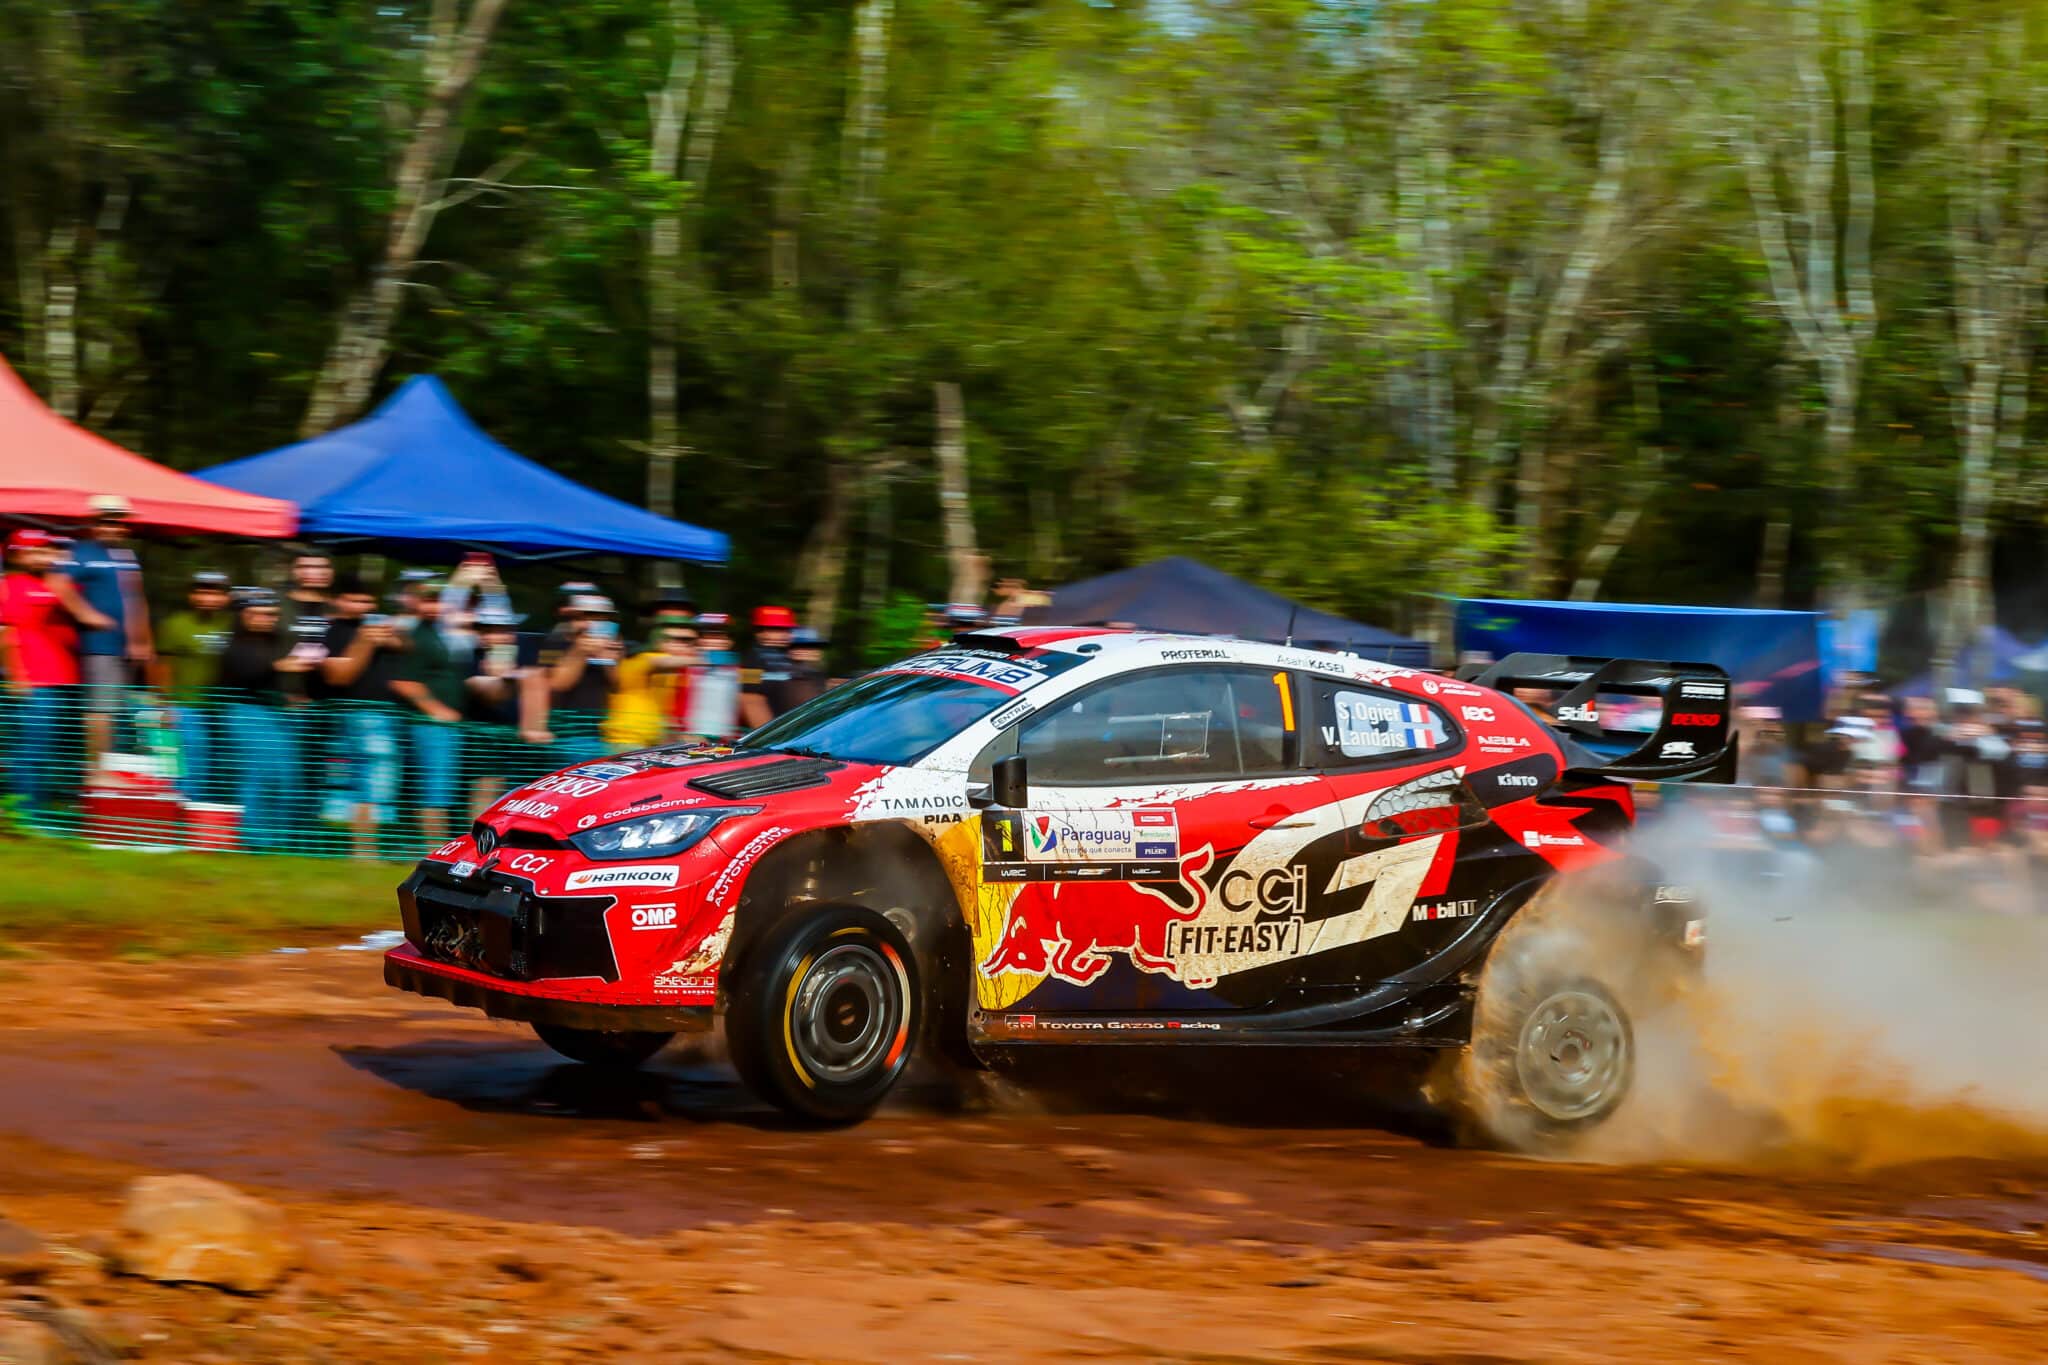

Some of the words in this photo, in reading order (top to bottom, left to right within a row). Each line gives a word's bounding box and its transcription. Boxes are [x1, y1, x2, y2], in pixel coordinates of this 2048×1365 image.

[1160, 649, 1231, 661] PROTERIAL
[1273, 671, 1296, 731] 1
[1557, 701, 1600, 722] Stilo
[523, 775, 609, 798] DENSO
[499, 799, 560, 818] TAMADIC
[603, 798, 701, 819] codebeamer
[882, 795, 964, 810] TAMADIC
[924, 813, 962, 825] PIAA
[995, 820, 1013, 852] 1
[1061, 828, 1131, 844] Paraguay
[705, 826, 781, 902] Panasonic
[714, 828, 792, 907] AUTOMOTIVE
[631, 907, 677, 925] OMP
[1412, 901, 1456, 921] Mobil
